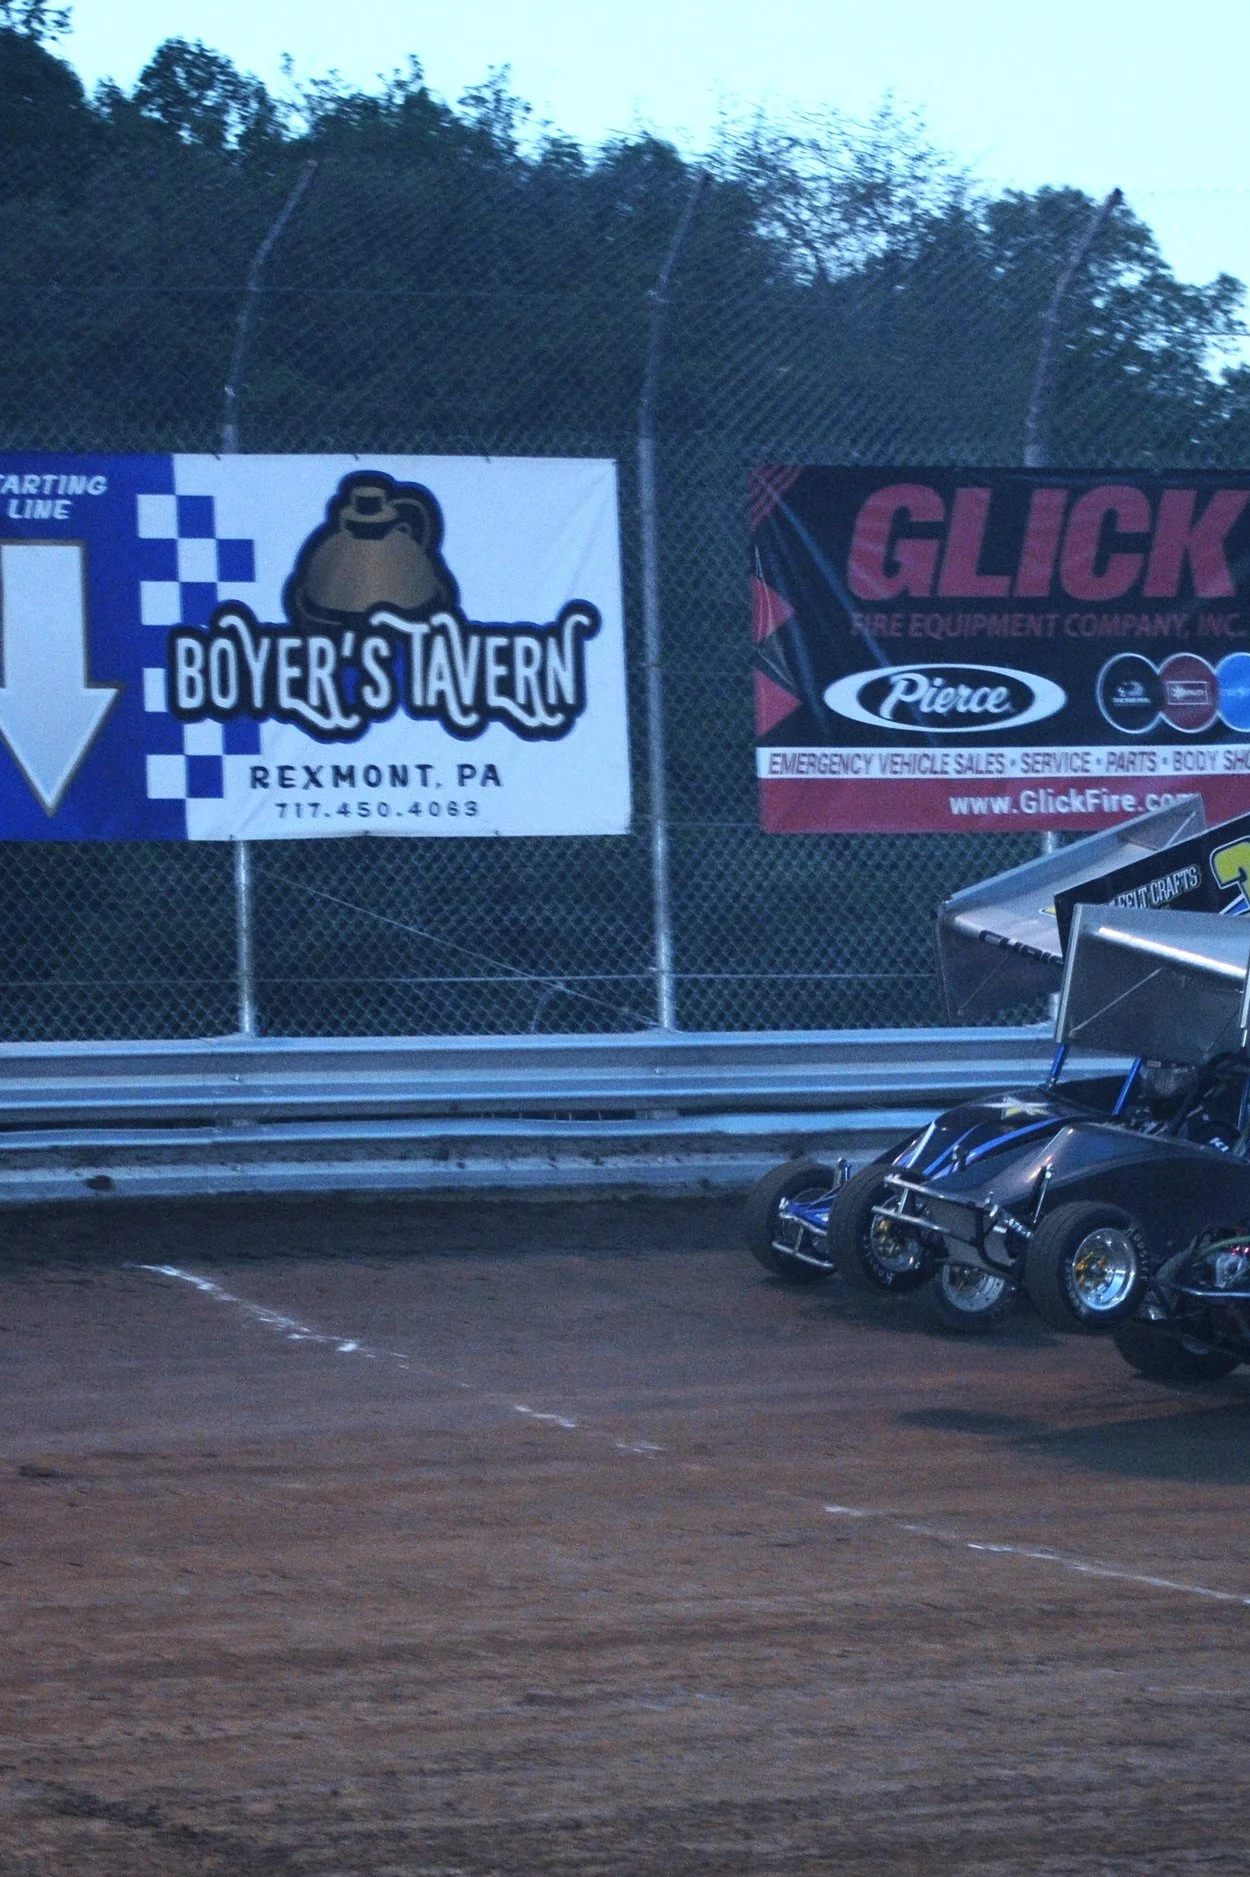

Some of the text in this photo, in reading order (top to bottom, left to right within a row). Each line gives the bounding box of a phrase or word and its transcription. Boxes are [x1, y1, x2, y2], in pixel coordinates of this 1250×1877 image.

[0, 474, 107, 495] ARTING
[8, 499, 72, 519] LINE
[851, 613, 902, 637] FIRE
[908, 613, 1058, 640] EQUIPMENT
[1065, 613, 1188, 639] COMPANY,
[175, 612, 591, 729] BOYER'S TAVERN
[879, 671, 1013, 720] Pierce
[457, 763, 503, 787] PA
[769, 753, 873, 775] EMERGENCY
[879, 752, 949, 775] VEHICLE
[954, 752, 1006, 774] SALES
[1020, 751, 1092, 773] SERVICE
[1106, 750, 1158, 773] PARTS
[1173, 749, 1220, 772] BODY
[275, 800, 479, 819] 717.450.4063
[1150, 866, 1198, 905] CRAFTS
